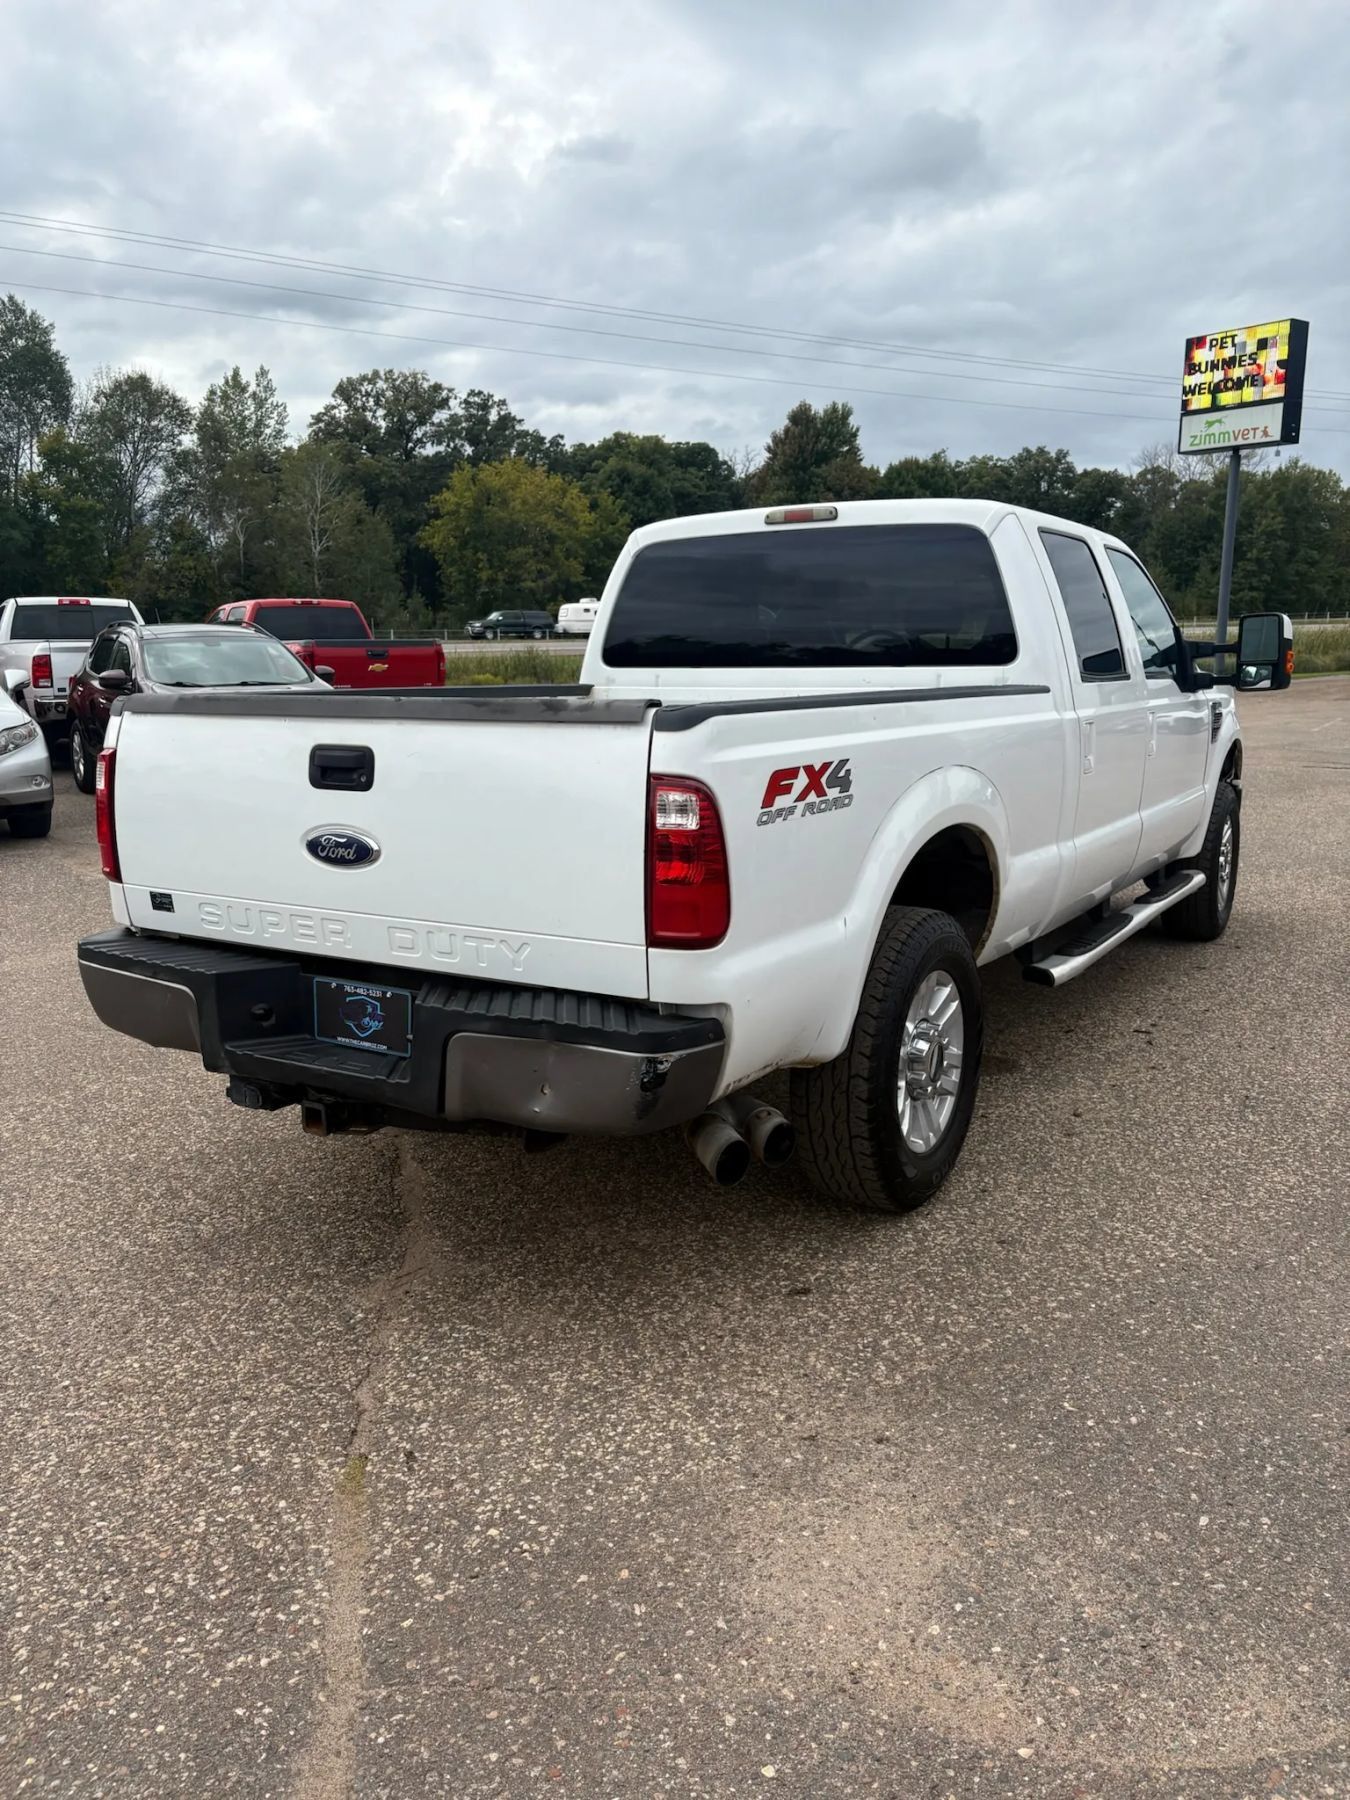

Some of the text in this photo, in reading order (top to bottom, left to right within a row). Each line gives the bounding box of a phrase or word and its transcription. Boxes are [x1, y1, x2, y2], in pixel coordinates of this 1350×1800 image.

[1209, 334, 1238, 352] PET
[1183, 374, 1260, 397] WELCOME
[760, 758, 852, 809] FX4
[756, 794, 854, 827] OFF ROAD
[317, 834, 358, 862] Ford
[198, 902, 353, 949] SUPER
[386, 925, 531, 972] DUTY
